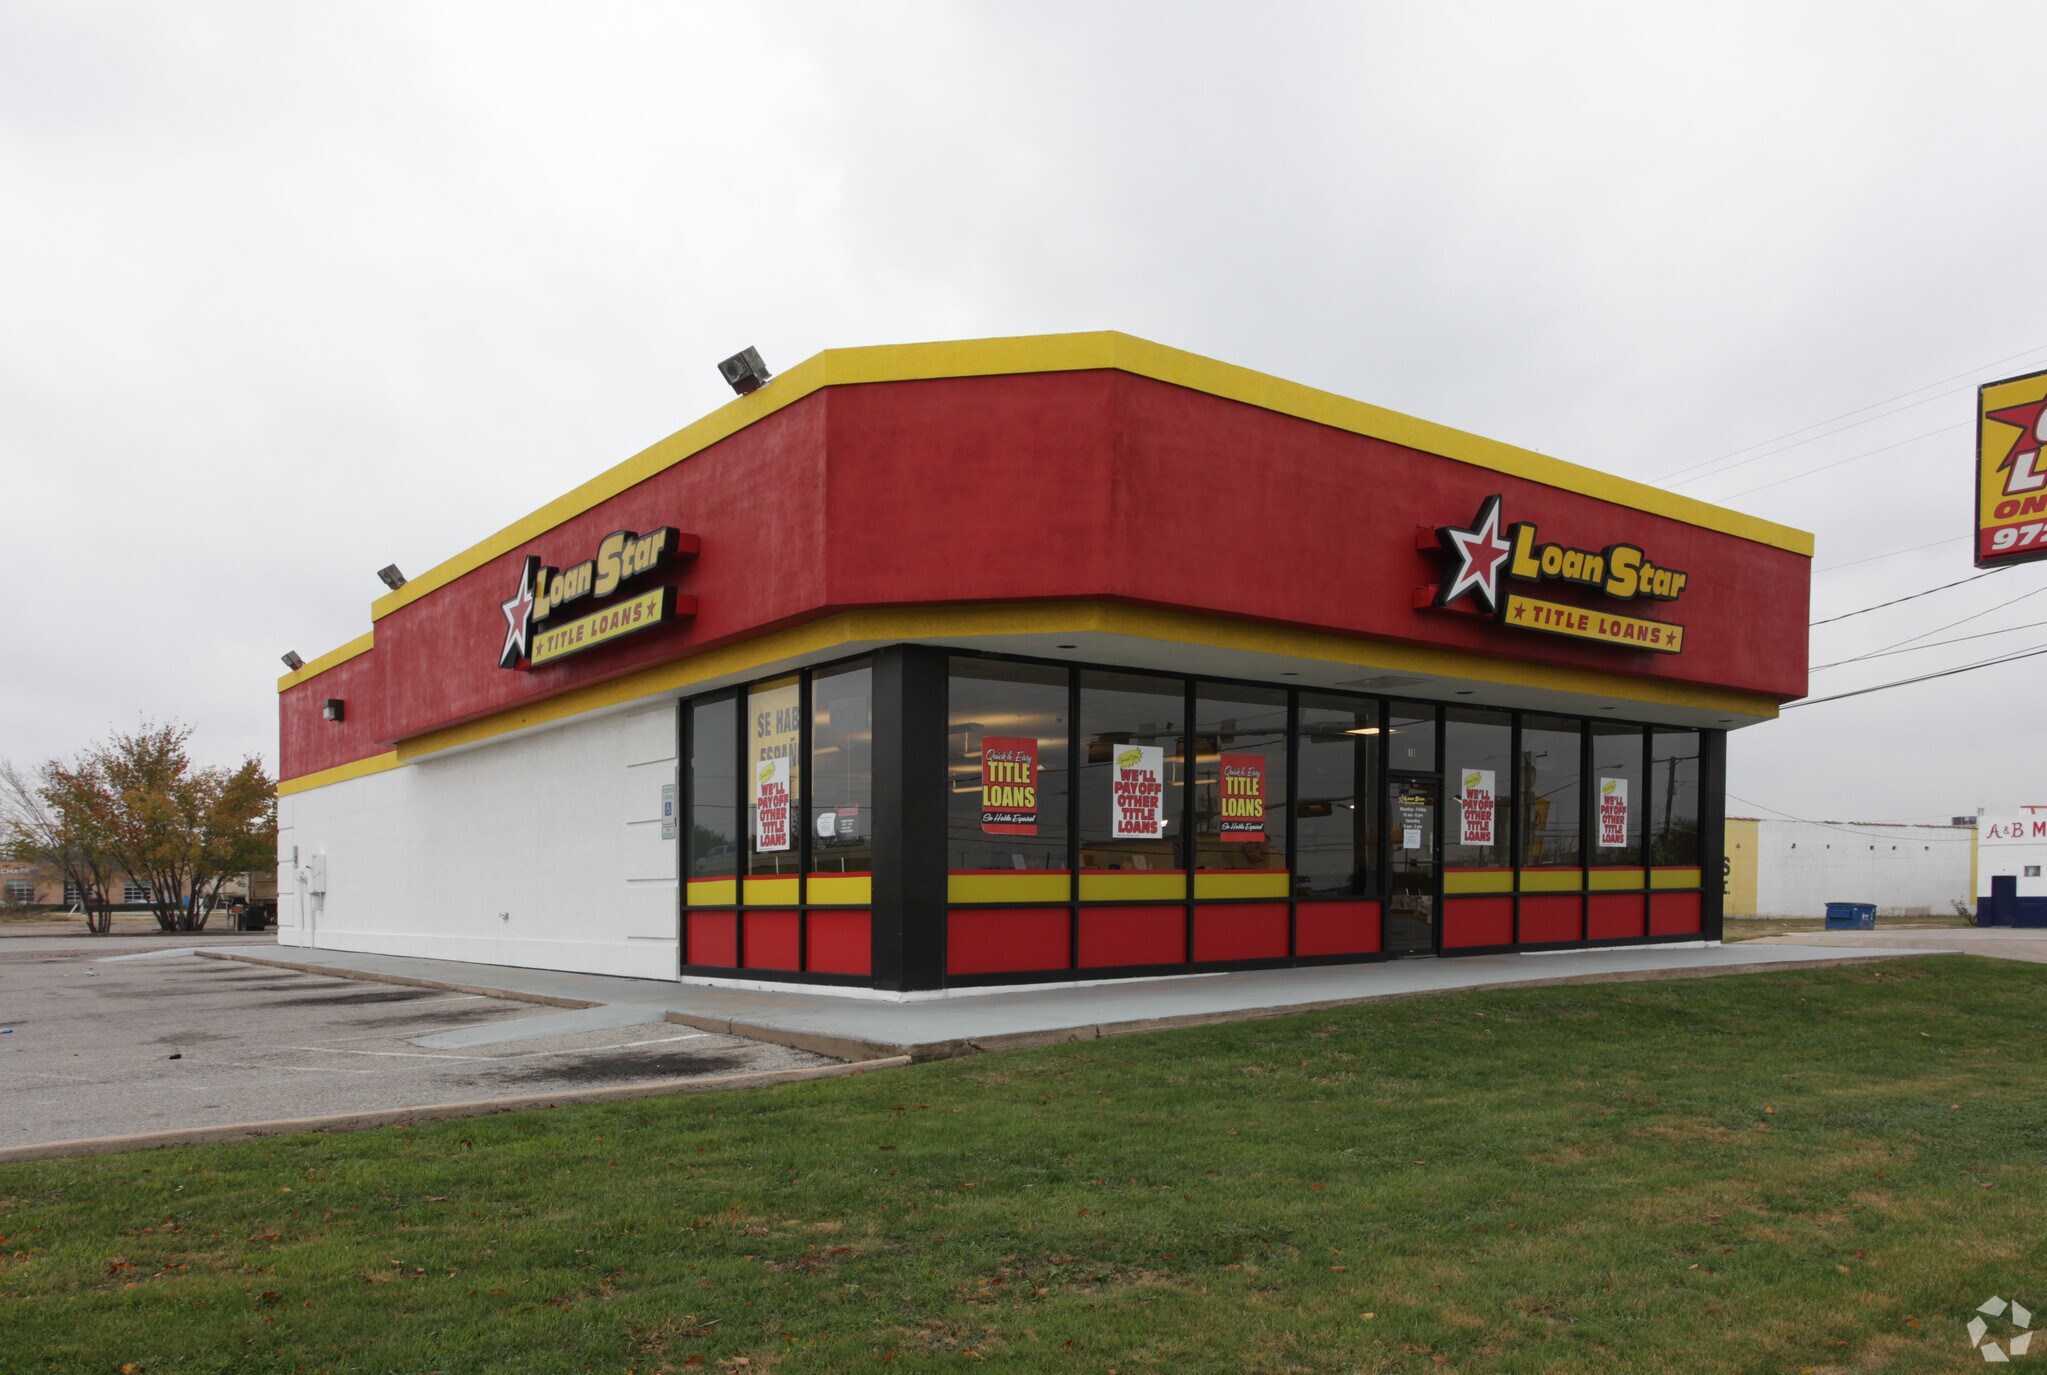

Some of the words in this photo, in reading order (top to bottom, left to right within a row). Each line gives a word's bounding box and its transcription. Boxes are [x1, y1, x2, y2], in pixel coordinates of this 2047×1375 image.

[1511, 524, 1605, 583] Loan
[1606, 546, 1687, 598] Star
[532, 561, 592, 621] Loan
[594, 527, 667, 597] Star
[547, 624, 585, 652] TITLE
[590, 602, 642, 637] LOANS
[1533, 606, 1590, 631] TITLE
[1598, 618, 1661, 644] LOANS
[757, 711, 771, 738] SE
[986, 749, 1006, 762] Quick
[987, 761, 1030, 783] TITLE
[1120, 769, 1156, 782] WE'LL
[761, 782, 785, 796] WE'LL
[1226, 776, 1259, 795] TITLE
[983, 785, 1035, 808] LOANS
[1117, 794, 1158, 808] OTHER
[1466, 788, 1490, 800] WE'LL
[1604, 796, 1623, 805] WE'LL
[759, 807, 787, 821] OTHER
[1121, 808, 1155, 820] TITLE
[1222, 798, 1263, 817] LOANS
[1464, 809, 1491, 821] OTHER
[1602, 814, 1624, 824] OTHER
[762, 820, 785, 834] TITLE
[1118, 820, 1157, 834] LOANS
[1467, 820, 1489, 831] TITLE
[1604, 824, 1622, 833] TITLE
[760, 833, 787, 847] LOANS
[1464, 831, 1490, 841] LOANS
[1602, 833, 1624, 843] LOANS
